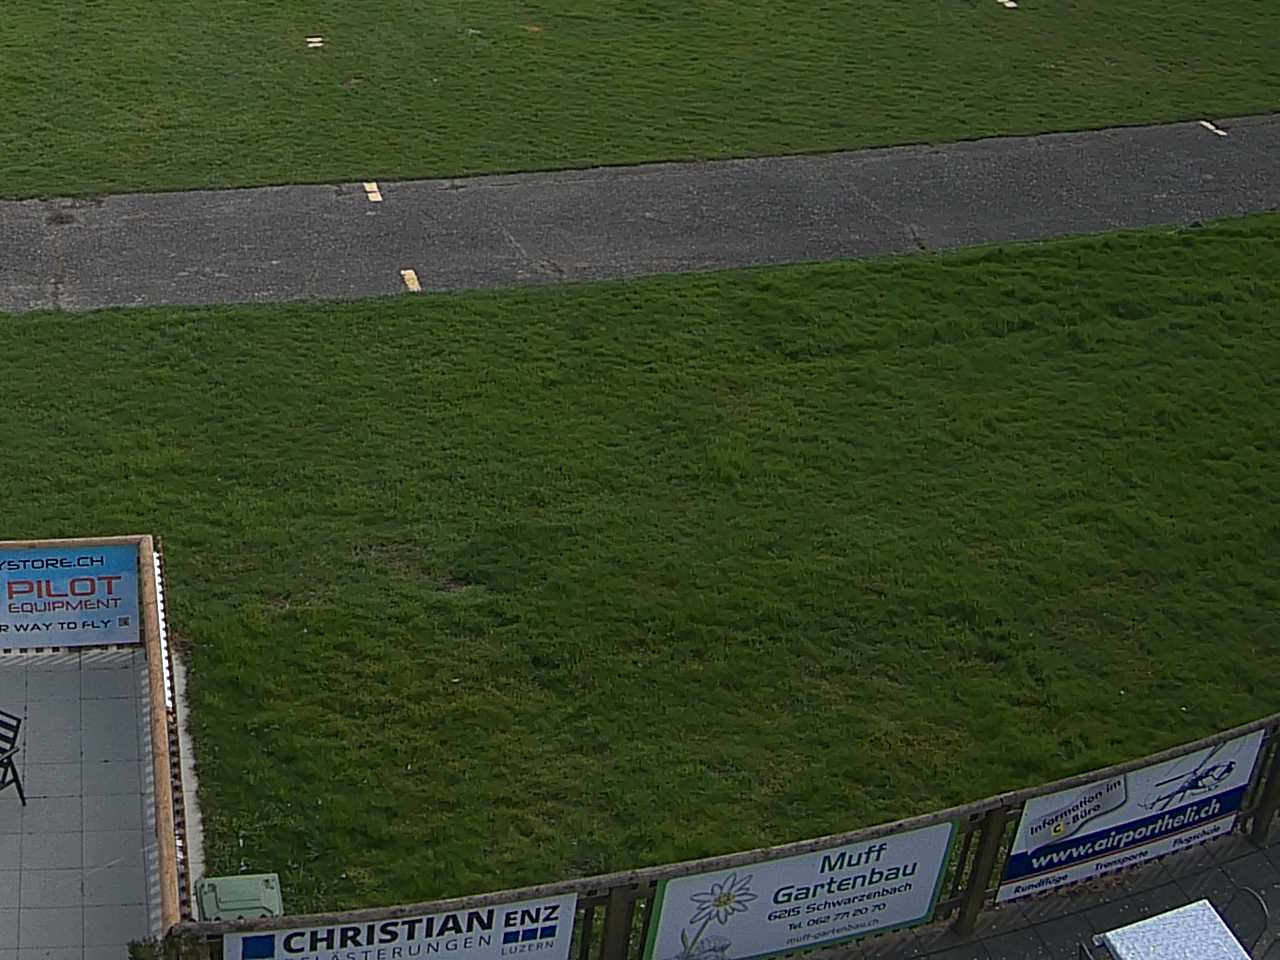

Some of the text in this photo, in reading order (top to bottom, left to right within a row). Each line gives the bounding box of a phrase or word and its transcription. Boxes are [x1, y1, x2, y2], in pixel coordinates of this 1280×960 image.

[7, 576, 122, 599] PILOT
[8, 598, 122, 614] EQUIPMENT
[13, 622, 52, 632] WAY
[57, 620, 77, 630] TO
[81, 618, 111, 629] FLY
[1030, 780, 1121, 835] Information im
[1032, 799, 1220, 868] www.airportheli.ch
[820, 843, 887, 873] Muff
[773, 862, 917, 904] Gartenbau
[768, 883, 912, 921] 6215 Schwarzenbach
[283, 905, 560, 953] CHRISTIAN ENZ
[807, 916, 830, 927] 062
[501, 941, 554, 956] LUZERN
